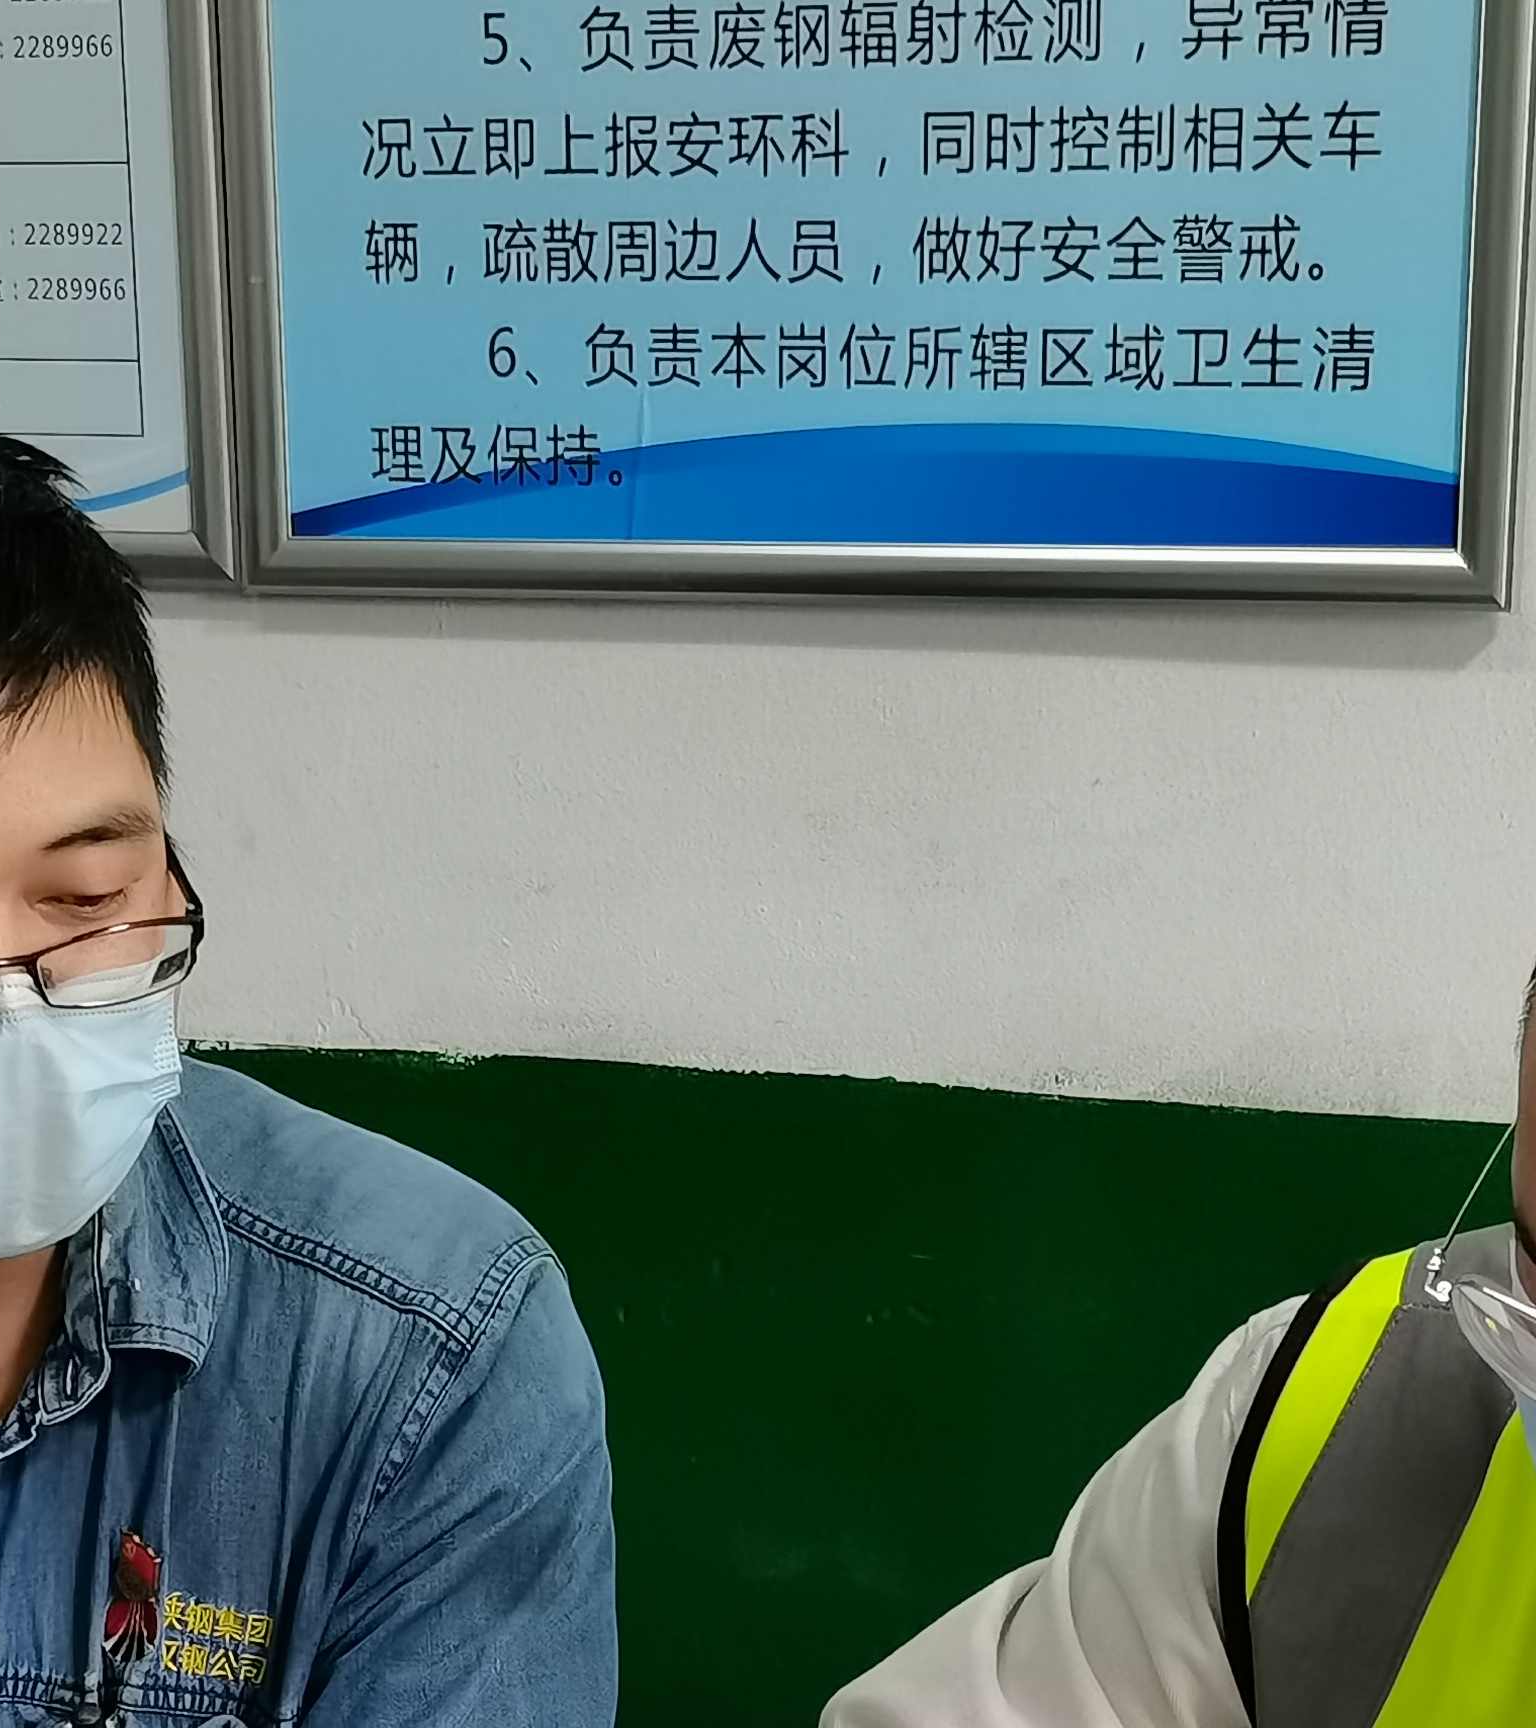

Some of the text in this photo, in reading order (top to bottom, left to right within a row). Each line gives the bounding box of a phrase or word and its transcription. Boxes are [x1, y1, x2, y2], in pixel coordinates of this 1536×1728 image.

[481, 0, 1388, 74] 5、负责废钢辐射检测，异常情
[360, 100, 1384, 185] 况立即上报安环科，同时控制相关车
[364, 211, 1333, 289] 辆，疏散周边人员，做好安全警戒。
[486, 322, 1377, 394] 6、负责本岗位所辖区域卫生清
[370, 423, 627, 490] 理及保持。
